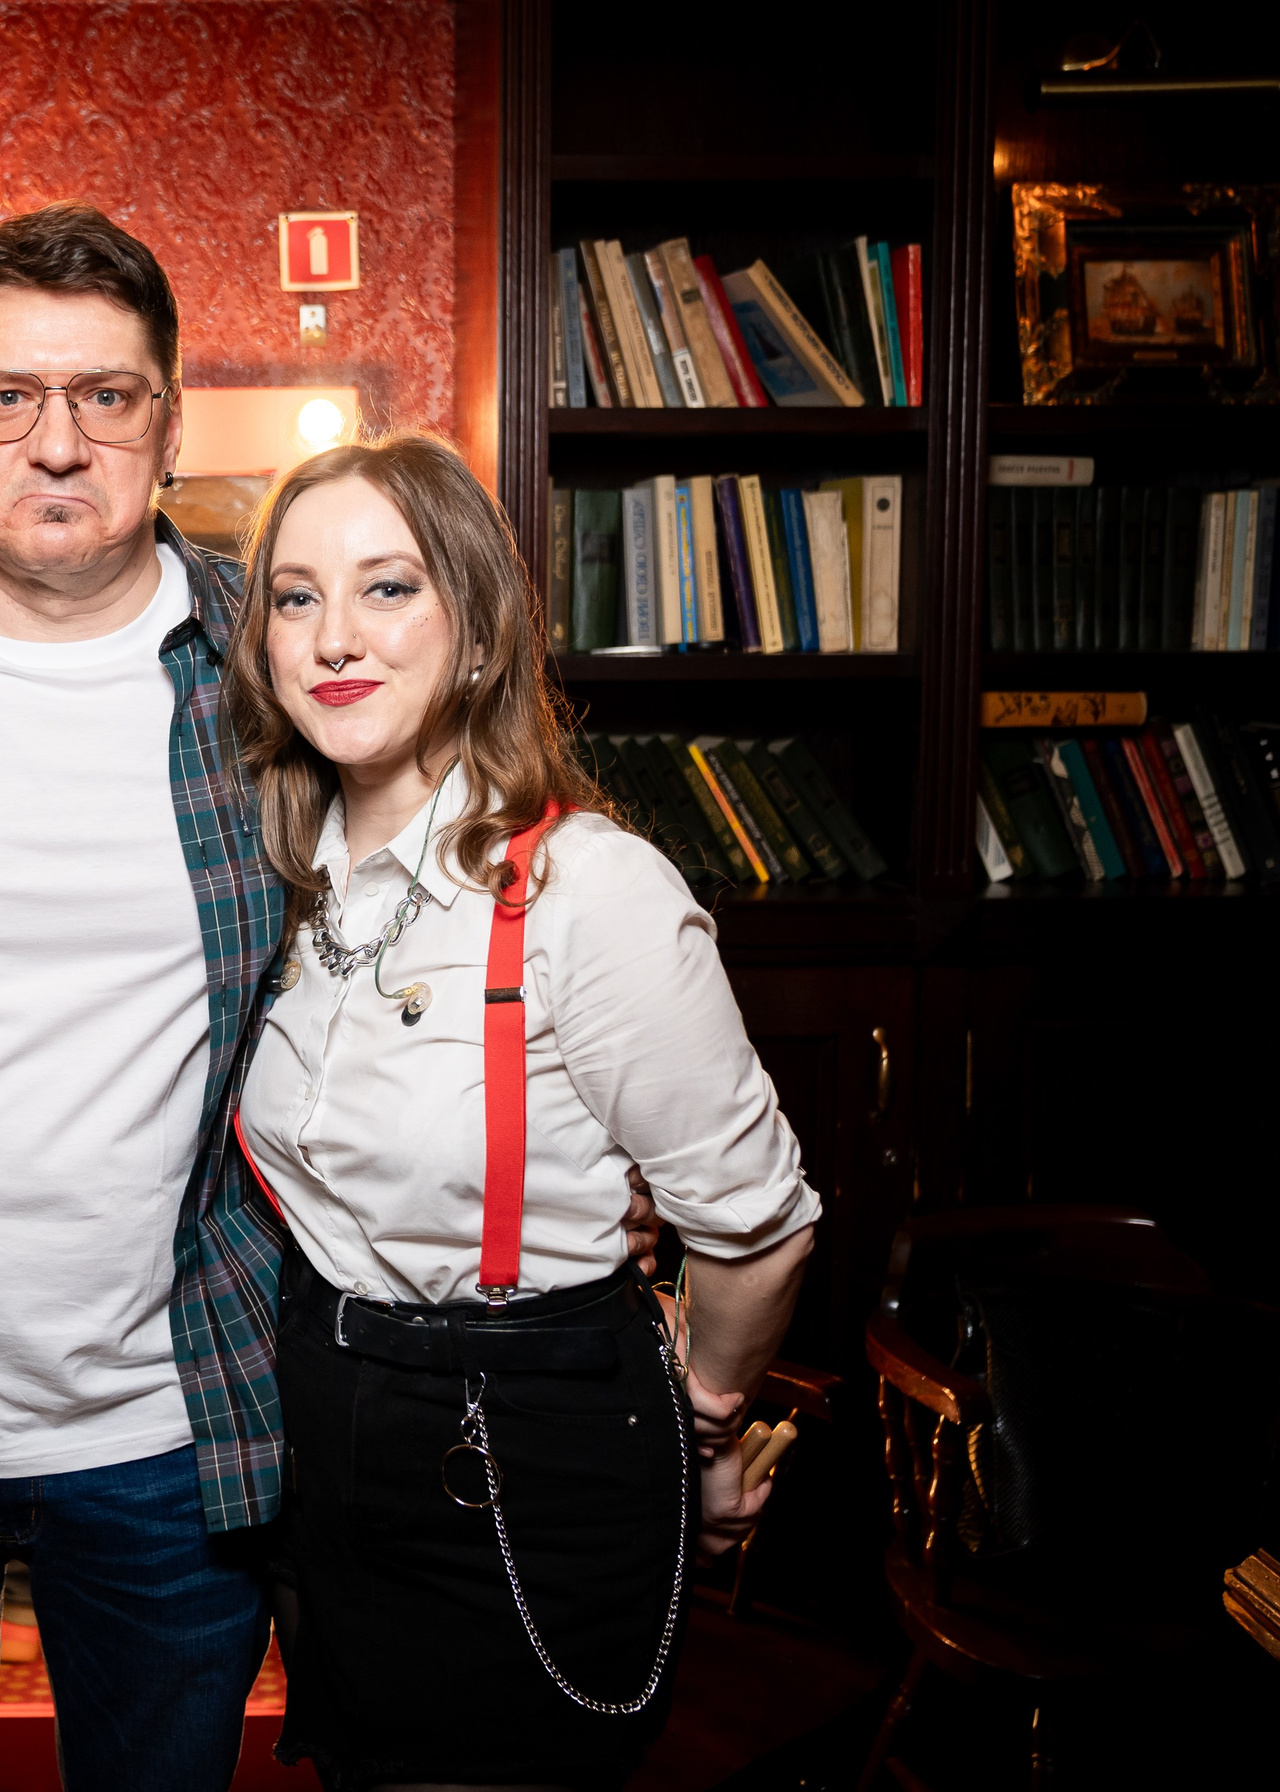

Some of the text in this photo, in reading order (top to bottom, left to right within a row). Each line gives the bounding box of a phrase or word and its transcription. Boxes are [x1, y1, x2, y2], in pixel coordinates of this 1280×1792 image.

[632, 498, 650, 640] ТВОРИ СВОЮ СУДЬБУ
